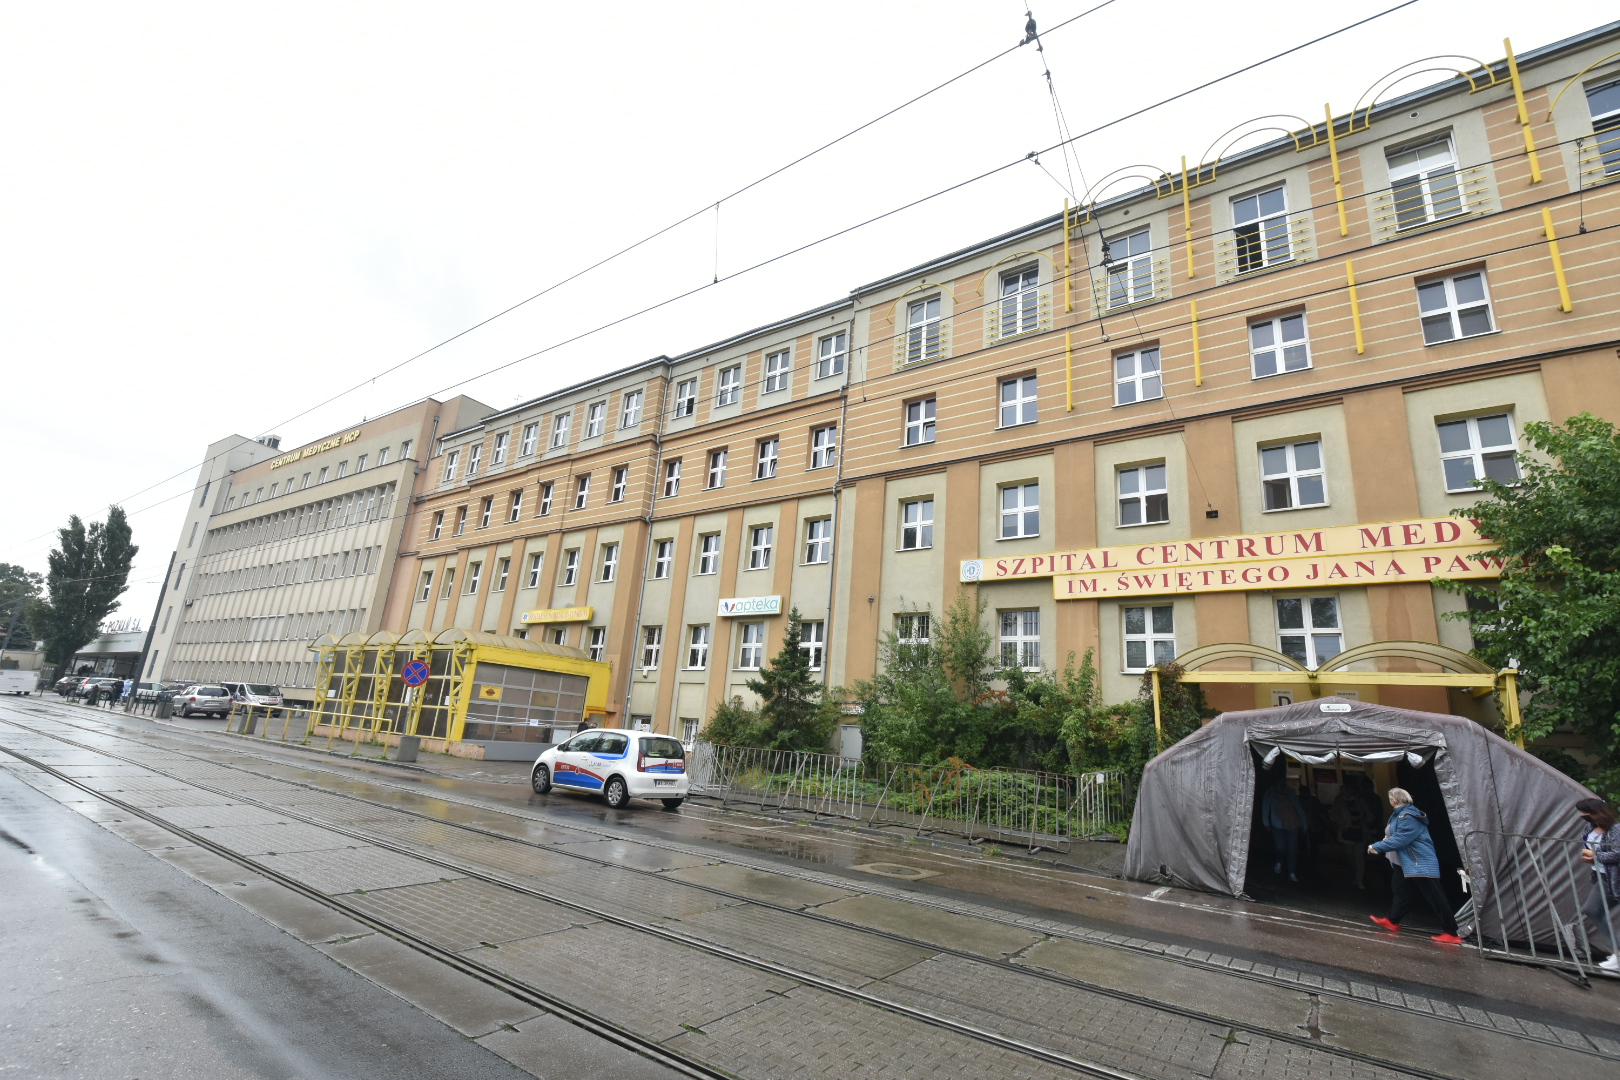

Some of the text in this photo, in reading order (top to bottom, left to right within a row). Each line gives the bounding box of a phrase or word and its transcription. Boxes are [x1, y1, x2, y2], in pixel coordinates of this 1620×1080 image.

[271, 430, 361, 470] CENTRUM MEDYCZNE HCP
[996, 550, 1118, 577] SZPITAL
[1136, 532, 1326, 565] CENTRUM
[1067, 578, 1107, 594] IM.
[1117, 565, 1290, 591] ŚWIĘTEGO
[1306, 558, 1406, 580] JANA
[736, 598, 778, 612] apteka
